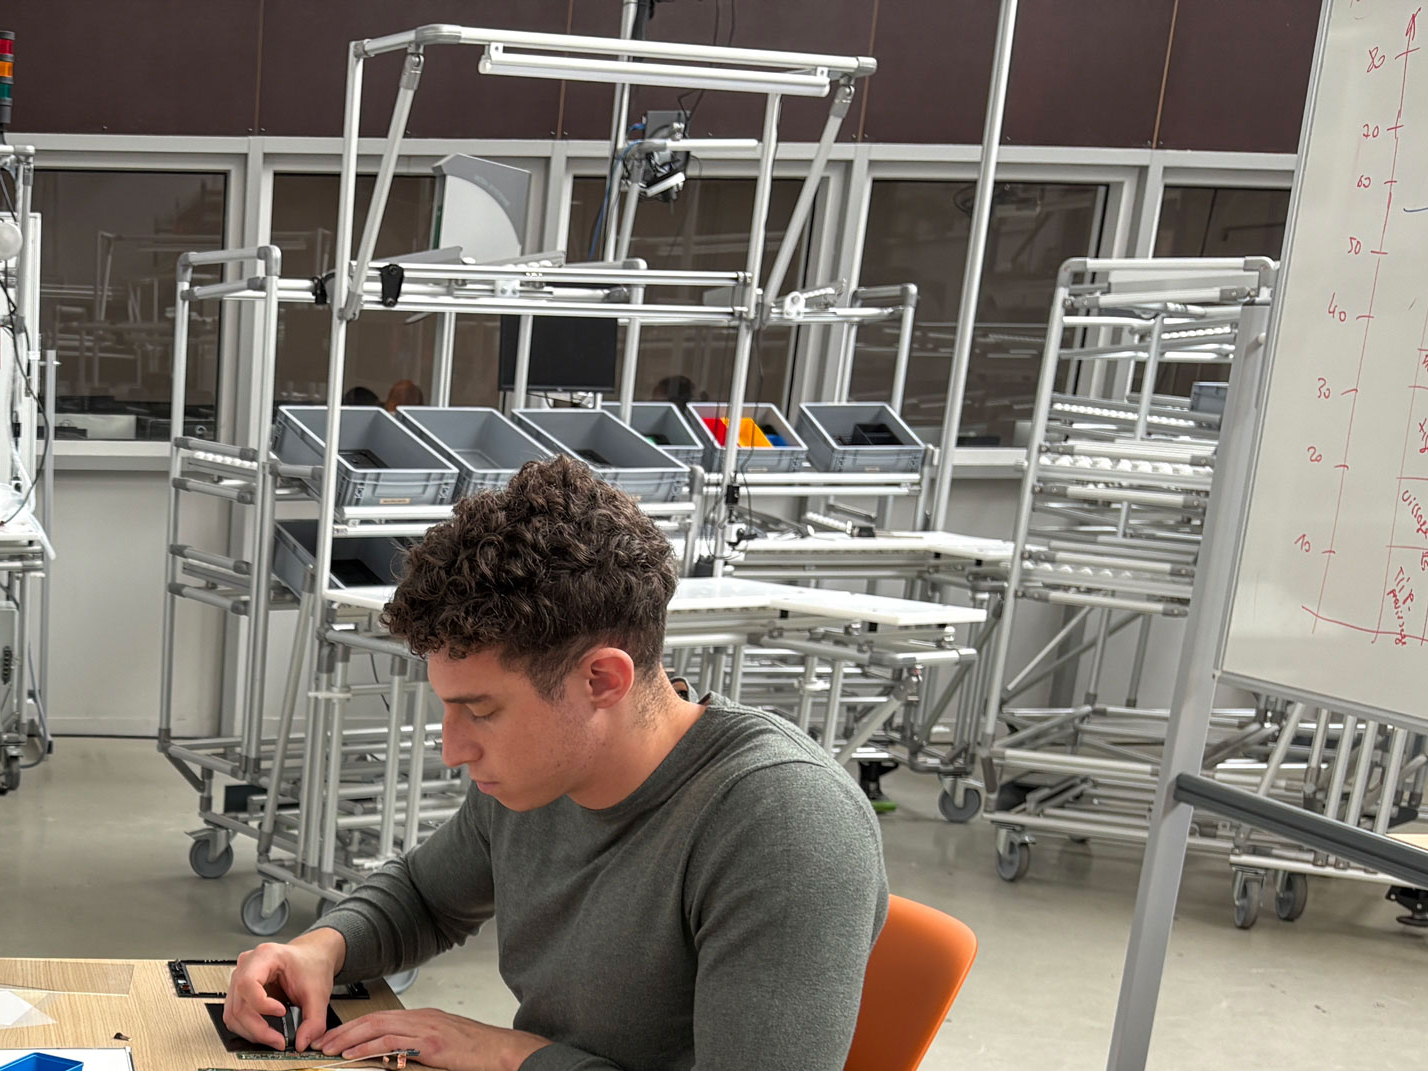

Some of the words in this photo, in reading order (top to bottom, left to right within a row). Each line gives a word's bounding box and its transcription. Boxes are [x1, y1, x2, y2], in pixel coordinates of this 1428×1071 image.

[1347, 236, 1362, 255] 50
[1328, 292, 1347, 322] 40
[1317, 377, 1331, 399] 30
[1307, 446, 1323, 462] 20
